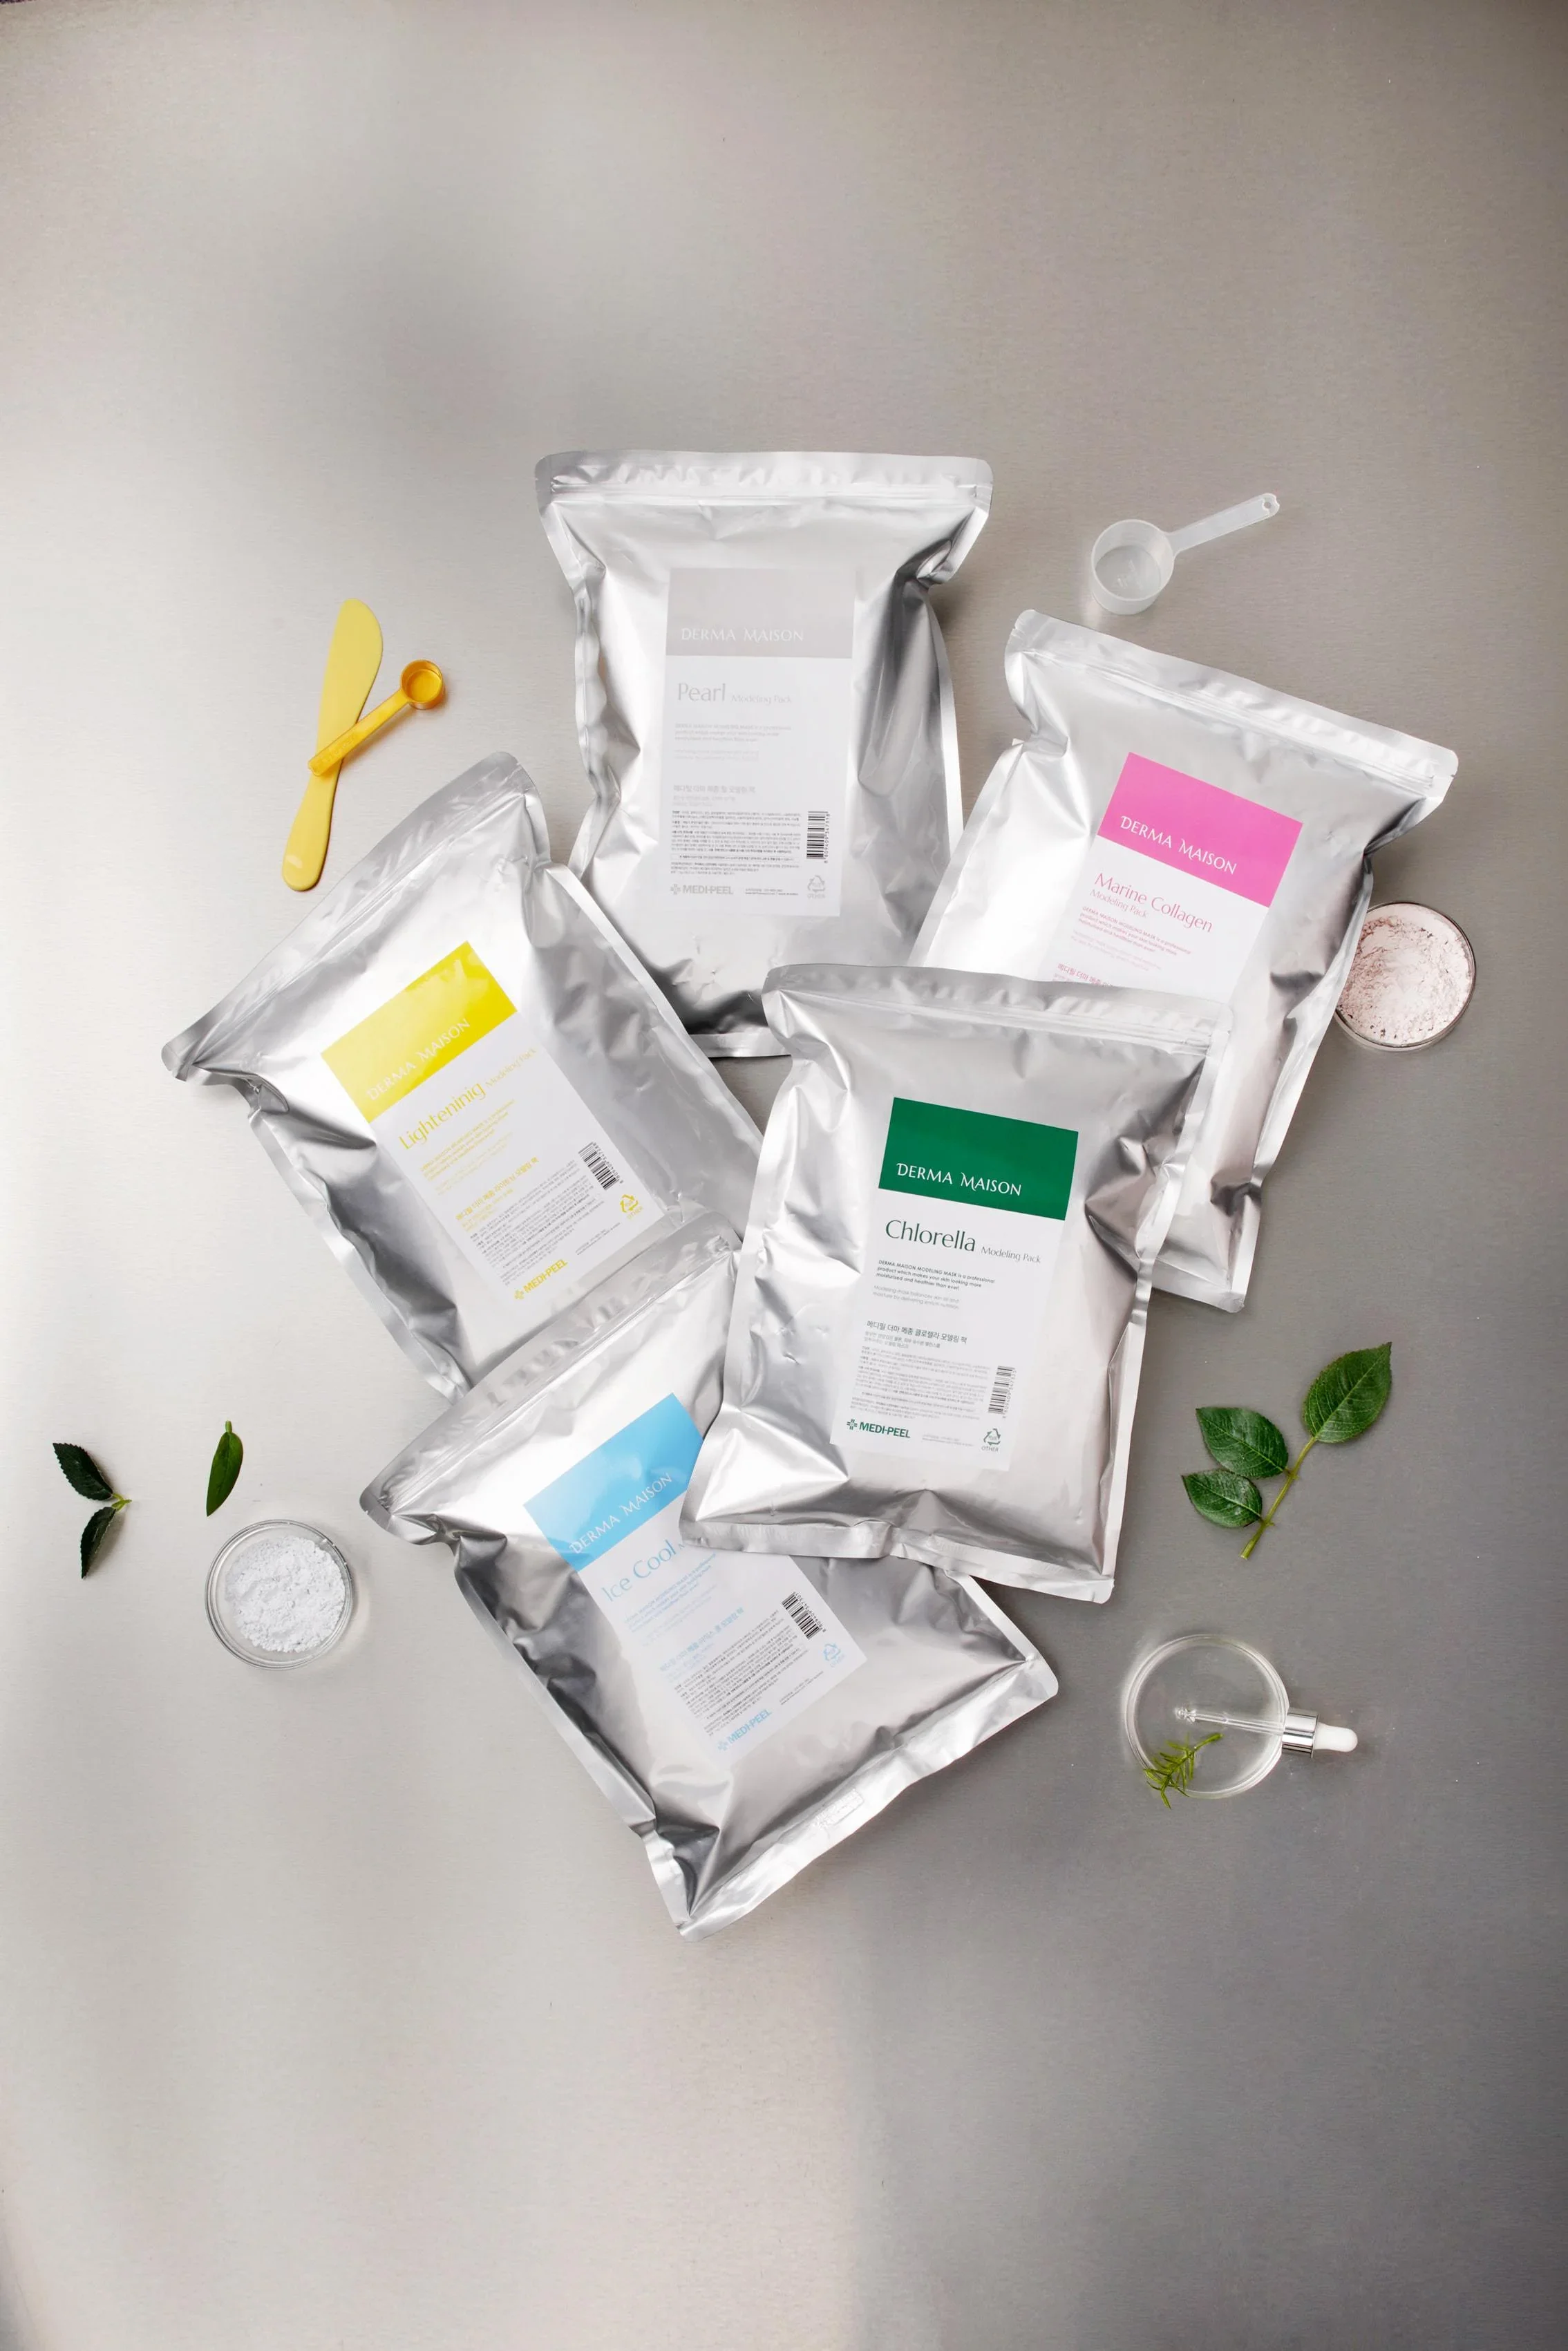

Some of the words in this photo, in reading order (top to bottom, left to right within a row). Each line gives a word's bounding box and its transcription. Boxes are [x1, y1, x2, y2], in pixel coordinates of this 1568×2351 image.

[681, 627, 736, 641] DERMA
[743, 627, 803, 642] MAISON
[677, 682, 726, 701] Pearl
[731, 694, 771, 704] Modeling
[773, 695, 791, 703] Pack
[1120, 815, 1171, 848] DERMA
[1178, 838, 1237, 874] MAISON
[682, 885, 733, 894] MEDI-PEEL
[1089, 888, 1128, 912] Modeling
[1129, 905, 1146, 917] Pack
[1094, 872, 1147, 903] Marine
[1151, 896, 1212, 932] Collagen
[366, 1061, 417, 1100] DERMA
[417, 1018, 470, 1060] MAISON
[896, 1162, 952, 1184] DERMA
[960, 1172, 1021, 1196] MAISON
[885, 1219, 975, 1252] Chlorella
[981, 1245, 1021, 1261] Modeling
[1022, 1253, 1040, 1263] Pack
[522, 1259, 567, 1292] MEDI-PEEL
[916, 1266, 942, 1274] MODELING
[858, 1421, 910, 1438] MEDI-PEEL
[569, 1515, 620, 1554] DERMA
[619, 1472, 672, 1516] MAISON
[601, 1577, 632, 1601] Ice
[632, 1539, 677, 1578] Cool
[728, 1708, 772, 1742] MEDI-PEEL
